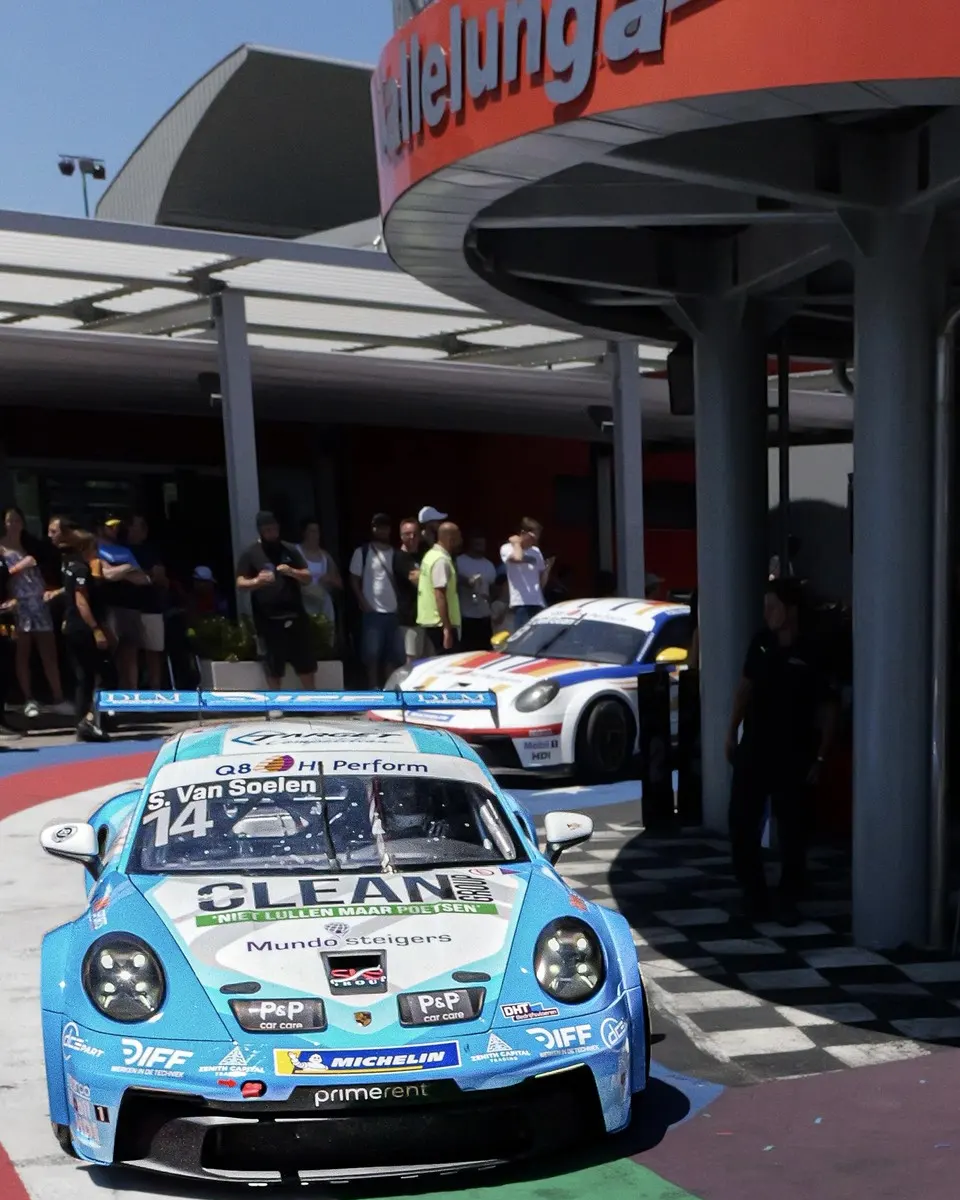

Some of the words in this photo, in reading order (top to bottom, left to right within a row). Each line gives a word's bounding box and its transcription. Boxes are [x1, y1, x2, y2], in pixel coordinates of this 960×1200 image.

[215, 763, 252, 776] Q8
[333, 759, 428, 773] Perform
[148, 791, 171, 811] S.
[176, 785, 223, 804] Van
[228, 776, 317, 797] Soelen
[142, 799, 214, 848] 14
[196, 873, 459, 912] CLEAN
[451, 874, 494, 903] GROUP
[264, 907, 334, 920] LULLEN
[338, 904, 391, 917] MAAR
[246, 936, 338, 952] Mundo
[345, 932, 452, 947] steigers
[259, 1000, 304, 1021] P&P
[418, 992, 460, 1014] P&P
[503, 1004, 529, 1017] DHT
[259, 1021, 278, 1029] car
[280, 1021, 303, 1029] care
[423, 1014, 441, 1023] car
[443, 1011, 464, 1021] care
[526, 1024, 592, 1049] DIFF
[330, 1051, 445, 1068] MICHELIN
[470, 1052, 500, 1062] ZENITH
[500, 1050, 532, 1058] CAPITAL
[314, 1082, 430, 1108] primerent
